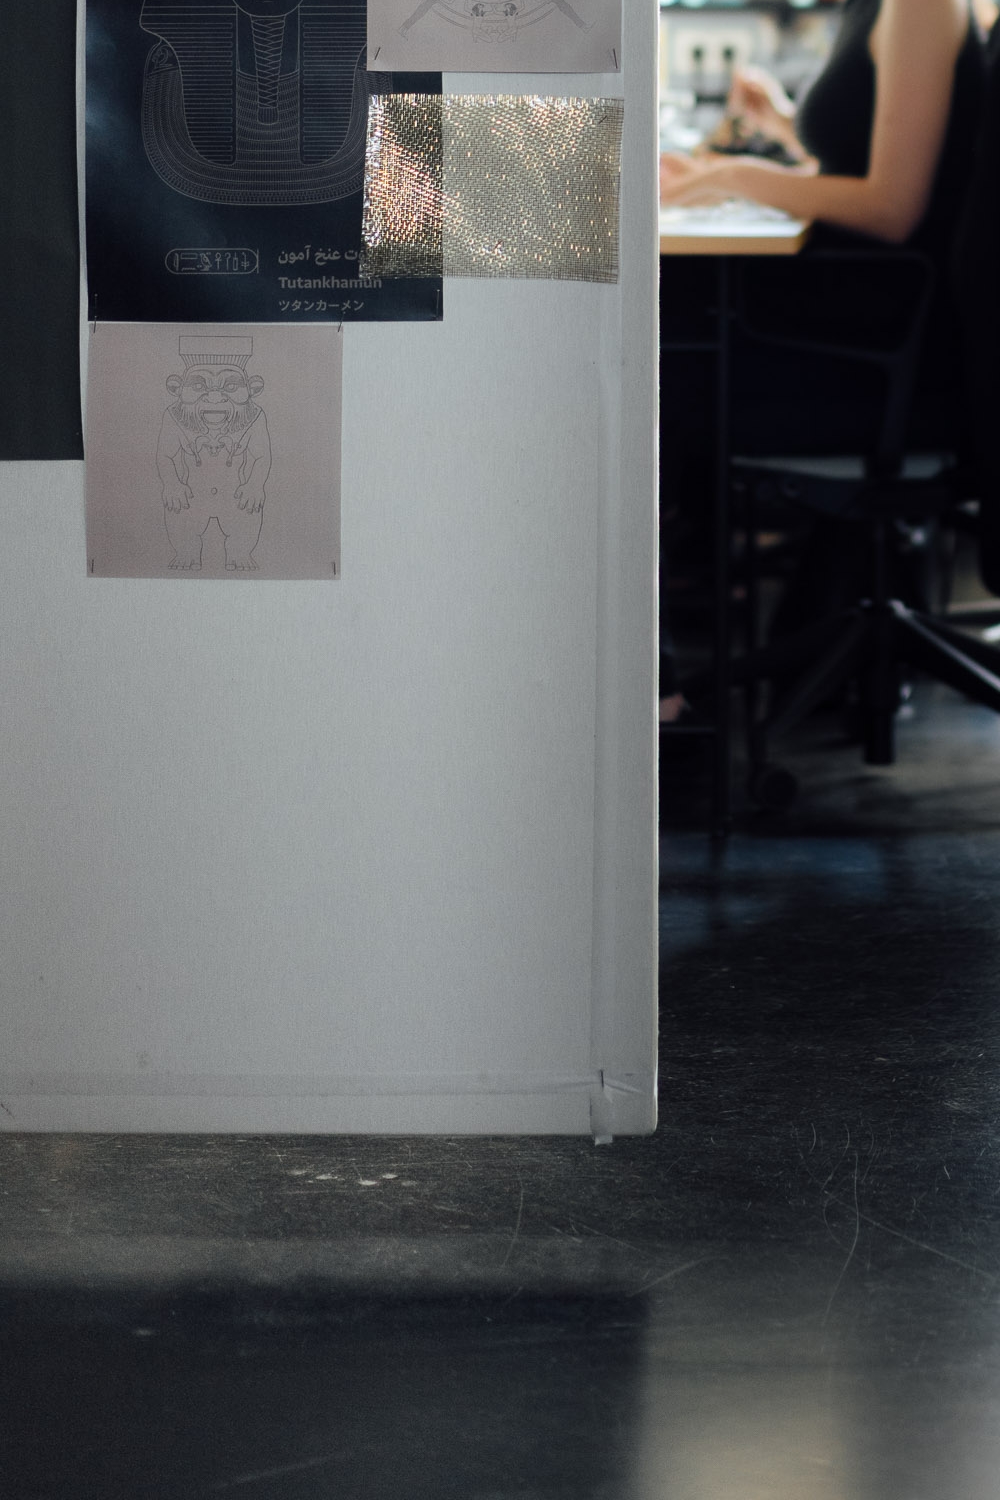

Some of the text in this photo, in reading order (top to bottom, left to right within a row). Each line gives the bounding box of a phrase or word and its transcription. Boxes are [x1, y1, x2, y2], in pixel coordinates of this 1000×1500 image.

[278, 244, 312, 264] آمون
[314, 247, 341, 265] عنخ
[278, 276, 383, 289] Tutankhamun
[278, 299, 365, 312] ツタンカーメン
